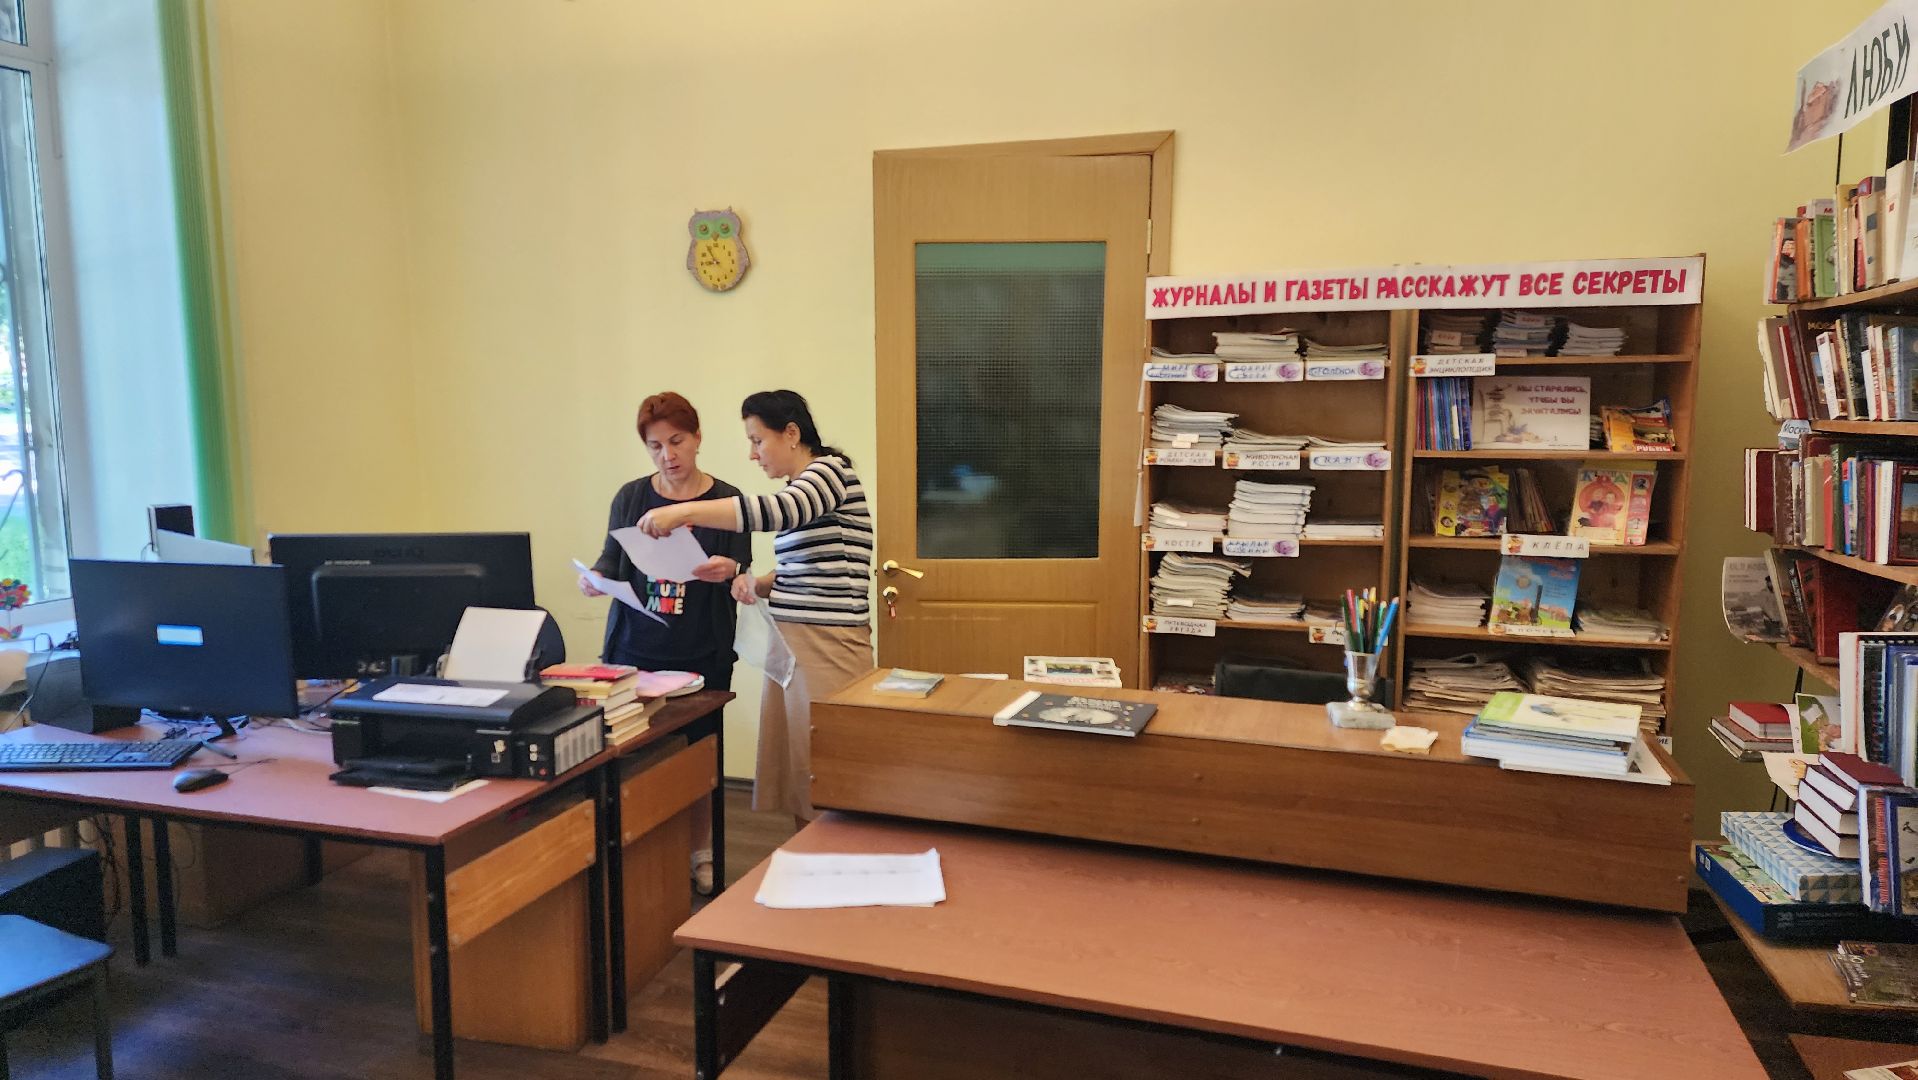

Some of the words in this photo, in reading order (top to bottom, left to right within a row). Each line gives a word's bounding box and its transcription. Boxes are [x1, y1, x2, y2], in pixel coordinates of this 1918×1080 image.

[1844, 16, 1910, 119] ЛЮБИ
[1152, 281, 1257, 308] ЖУРНАЛЫ
[1263, 280, 1277, 302] И
[1285, 277, 1369, 301] ГАЗЕТЫ
[1376, 274, 1511, 299] РАССКАЖУТ
[1518, 271, 1565, 297] ВСЕ
[1572, 268, 1688, 295] СЕКРЕТЫ
[1532, 540, 1586, 551] КЛЁПА
